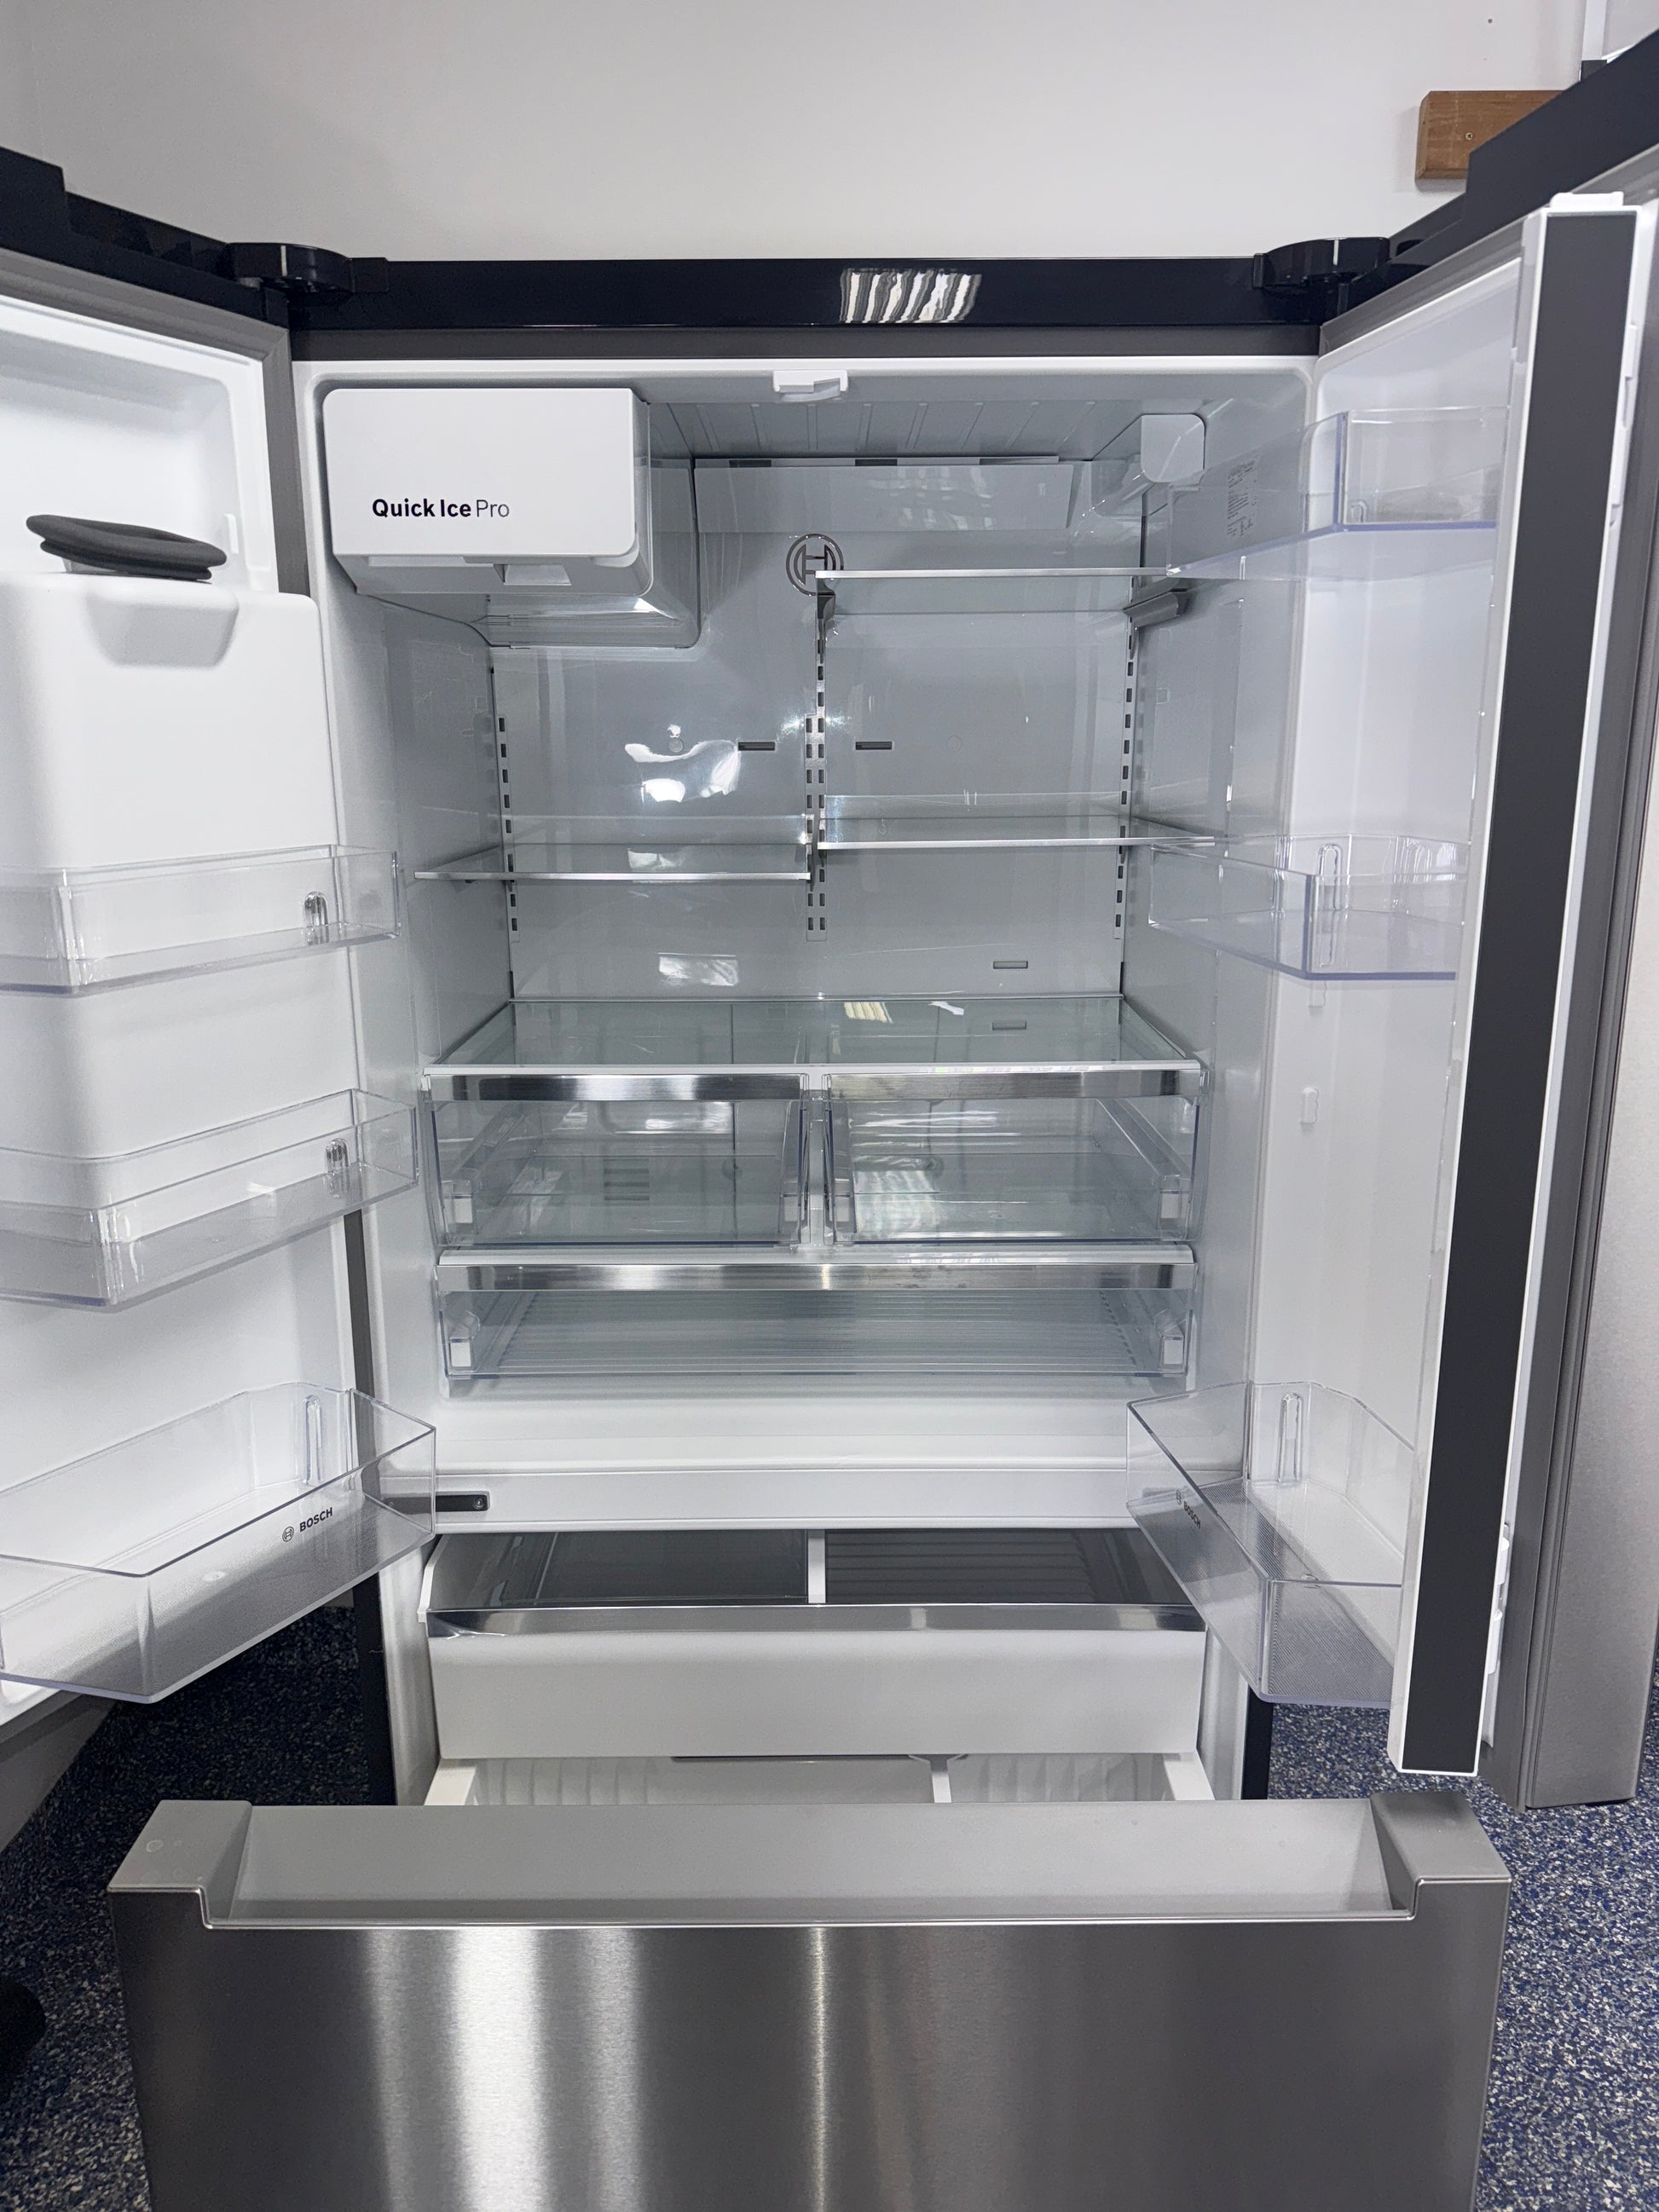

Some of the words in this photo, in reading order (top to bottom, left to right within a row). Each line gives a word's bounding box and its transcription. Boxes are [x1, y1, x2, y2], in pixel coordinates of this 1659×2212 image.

[373, 498, 436, 518] Quick
[440, 499, 471, 517] Ice
[476, 499, 510, 517] Pro
[299, 1507, 333, 1533] BOSCH
[1183, 1500, 1201, 1529] BOSCH
